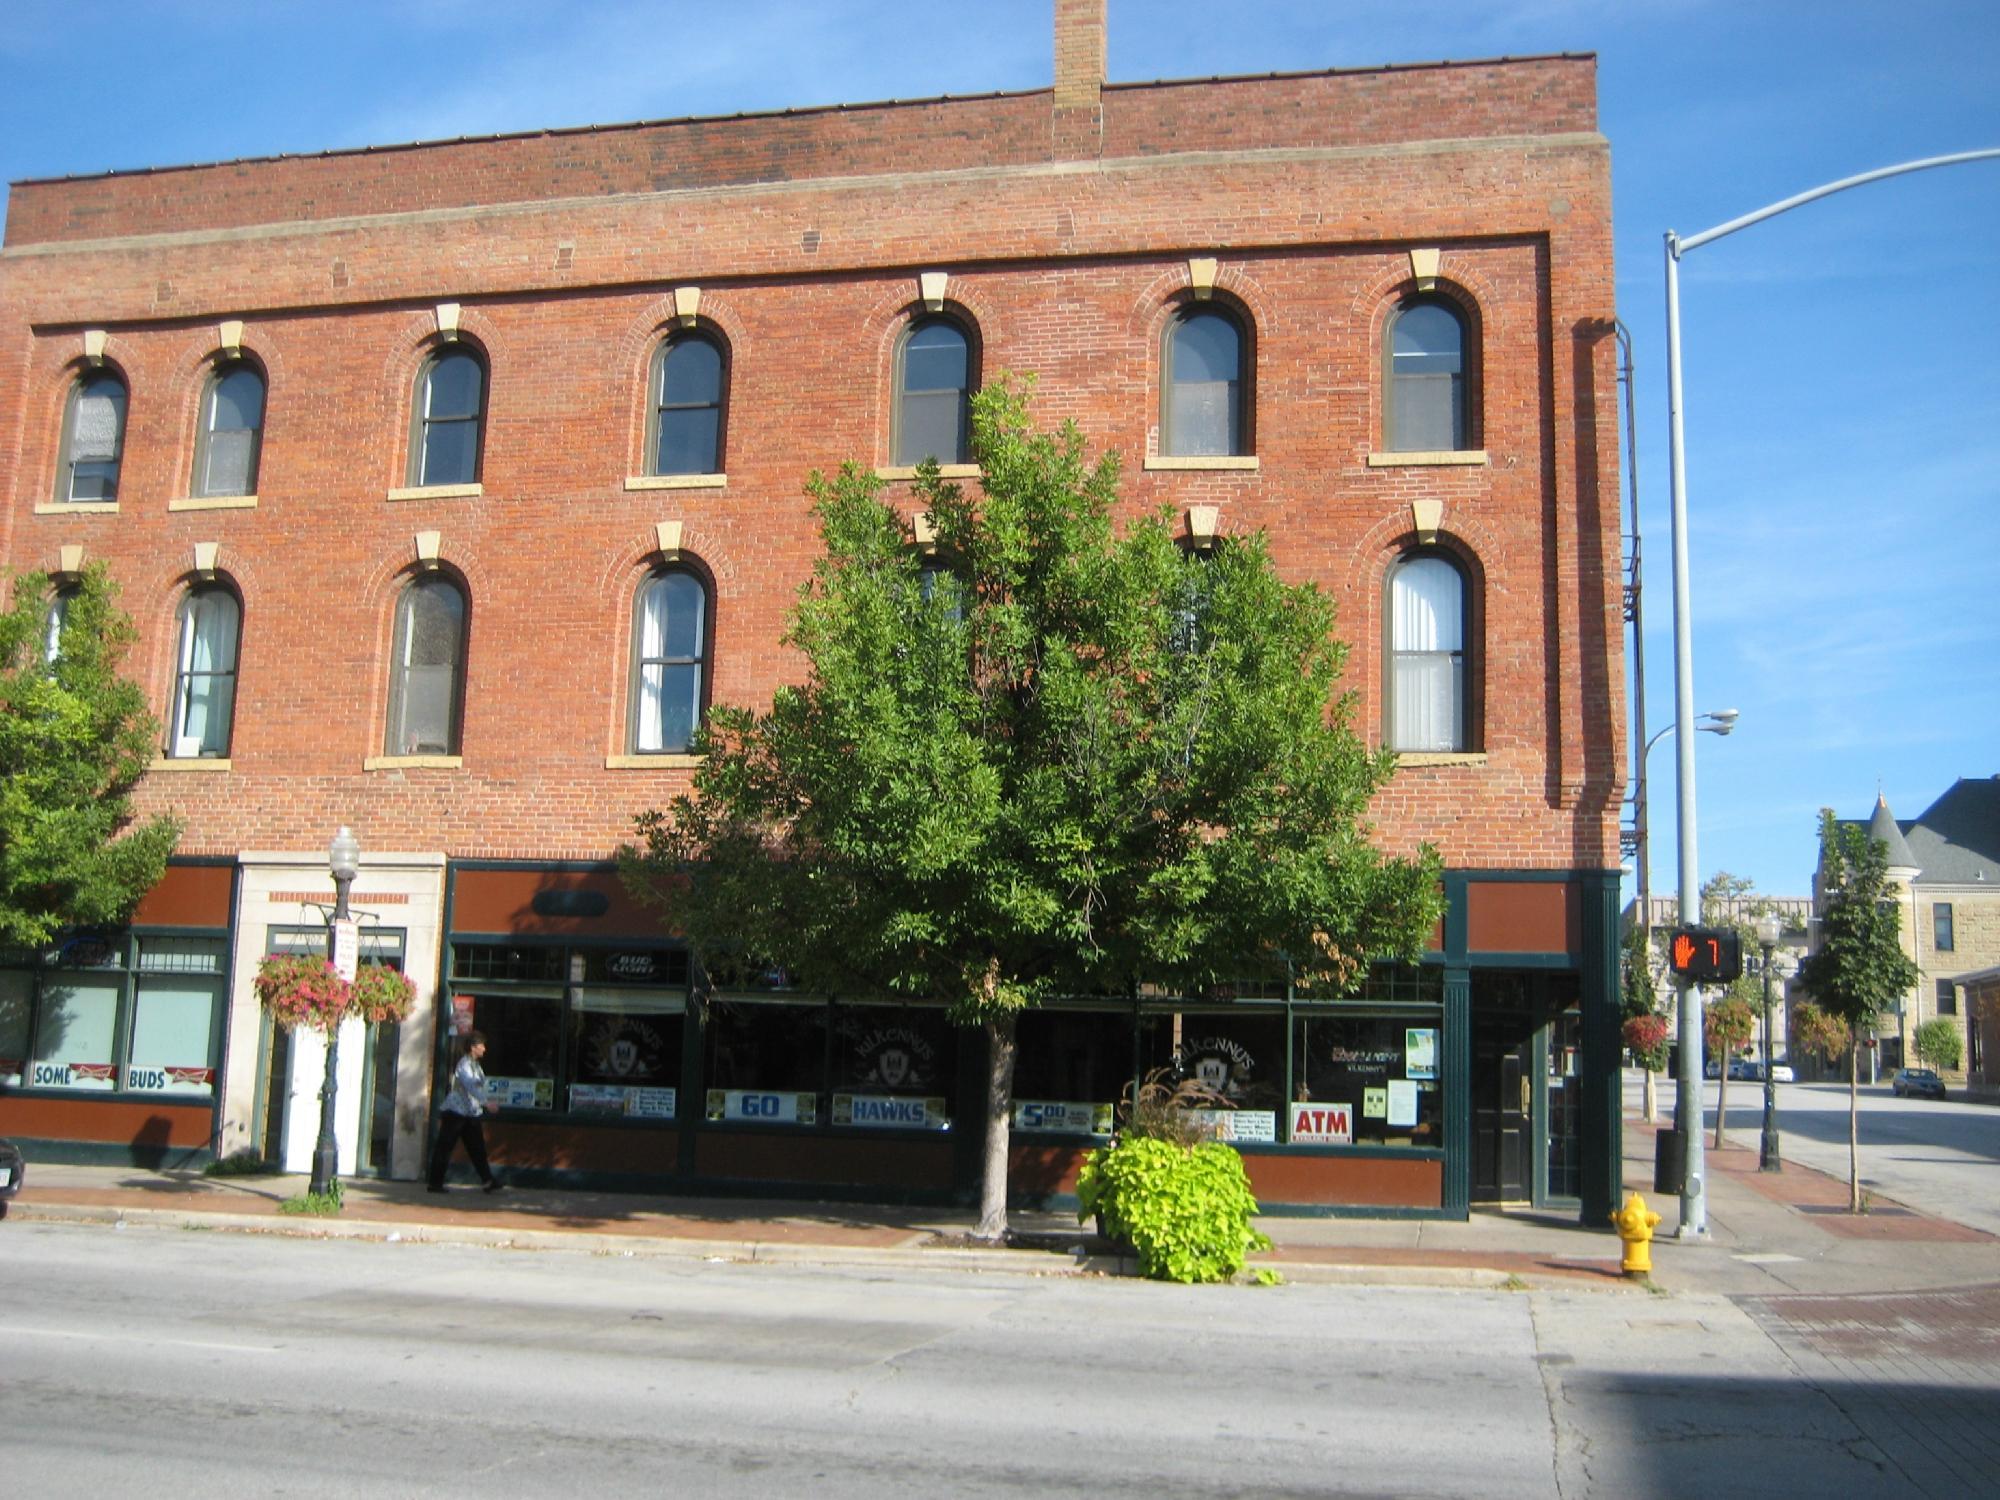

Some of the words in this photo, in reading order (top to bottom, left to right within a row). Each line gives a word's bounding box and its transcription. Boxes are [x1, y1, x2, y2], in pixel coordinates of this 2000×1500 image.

[34, 1065, 71, 1085] SOME
[129, 1071, 165, 1090] BUDS
[741, 1095, 780, 1117] GO
[853, 1102, 924, 1122] HAWKS
[1295, 1110, 1348, 1134] ATM
